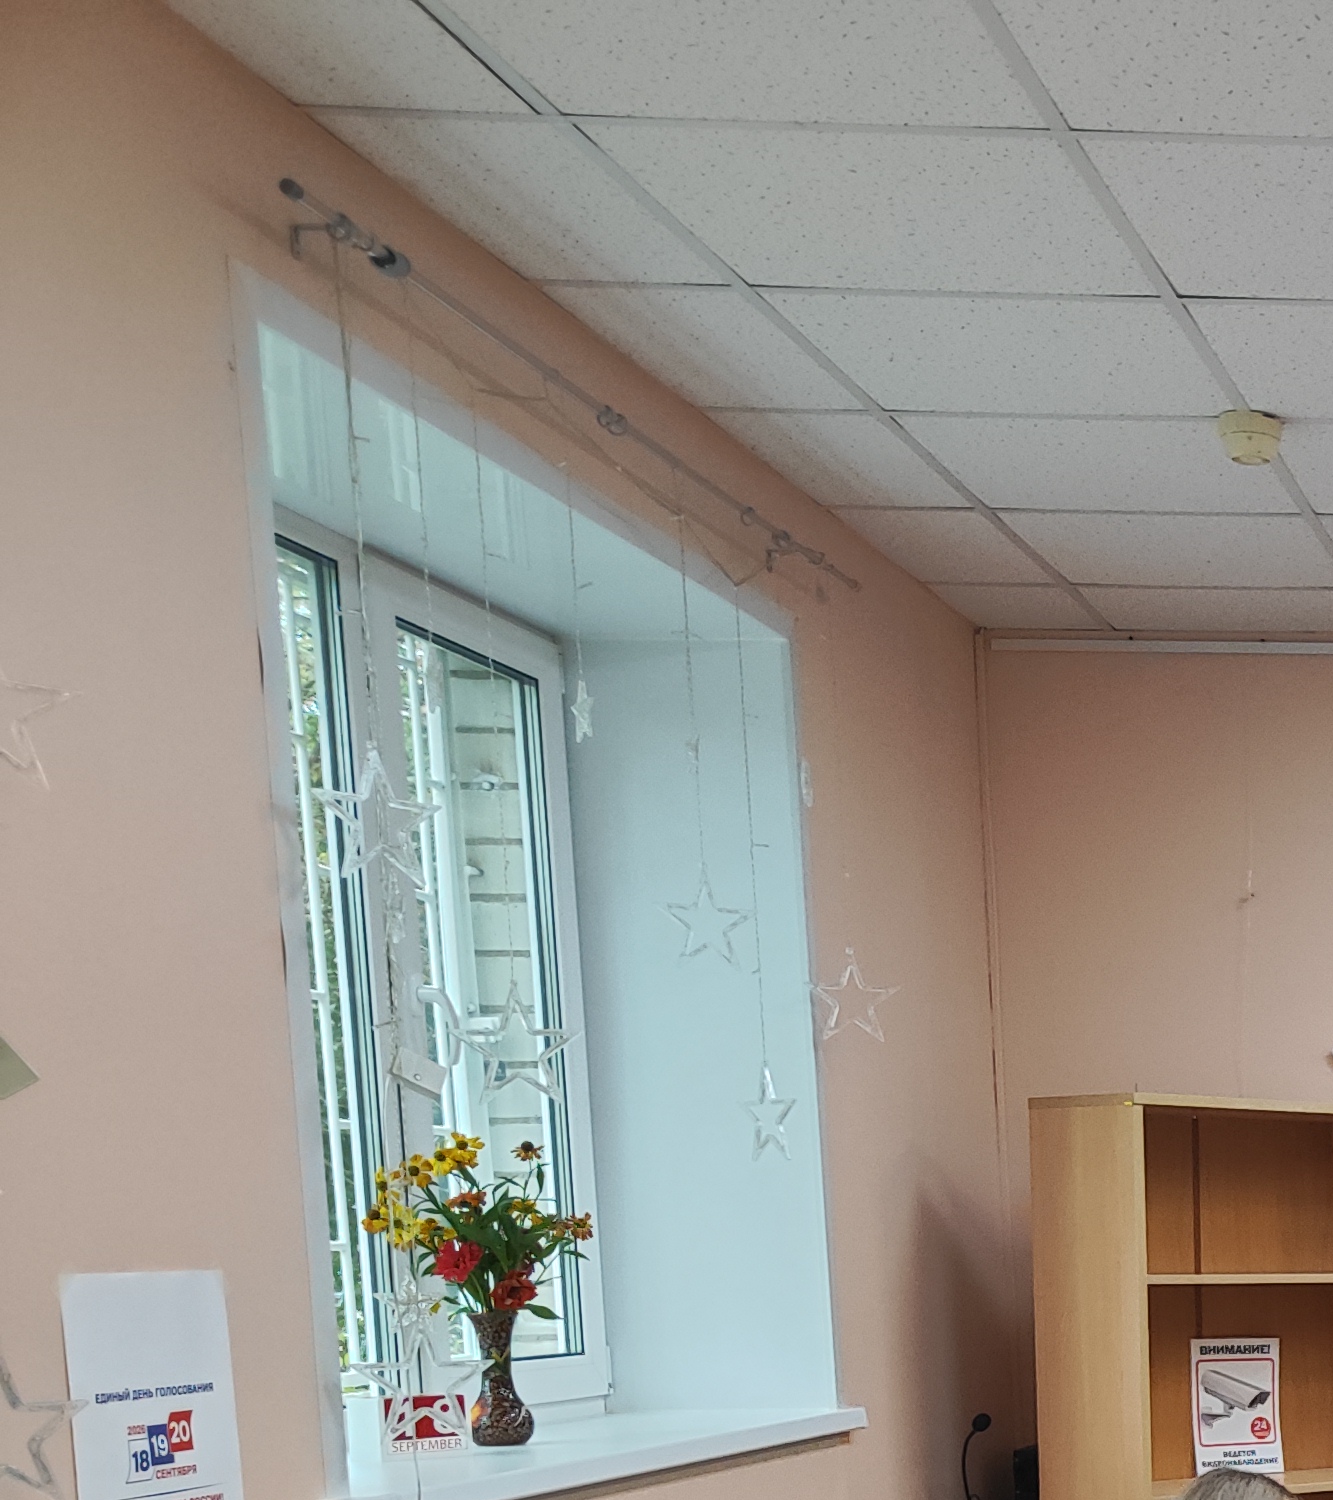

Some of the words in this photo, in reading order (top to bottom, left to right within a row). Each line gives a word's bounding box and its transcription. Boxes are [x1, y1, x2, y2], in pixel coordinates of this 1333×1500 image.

[1199, 1344, 1270, 1355] ВНИМАНИЕ!
[95, 1388, 130, 1404] ЕДИНЫЙ
[132, 1388, 153, 1400] ДЕНЬ
[155, 1382, 214, 1397] ГОЛОСОВАНИЯ
[132, 1450, 150, 1473] 18
[151, 1434, 168, 1457] 19
[169, 1420, 190, 1444] 20
[391, 1438, 462, 1453] SEPTEMBER
[155, 1464, 197, 1479] СЕНТЯБРЯ
